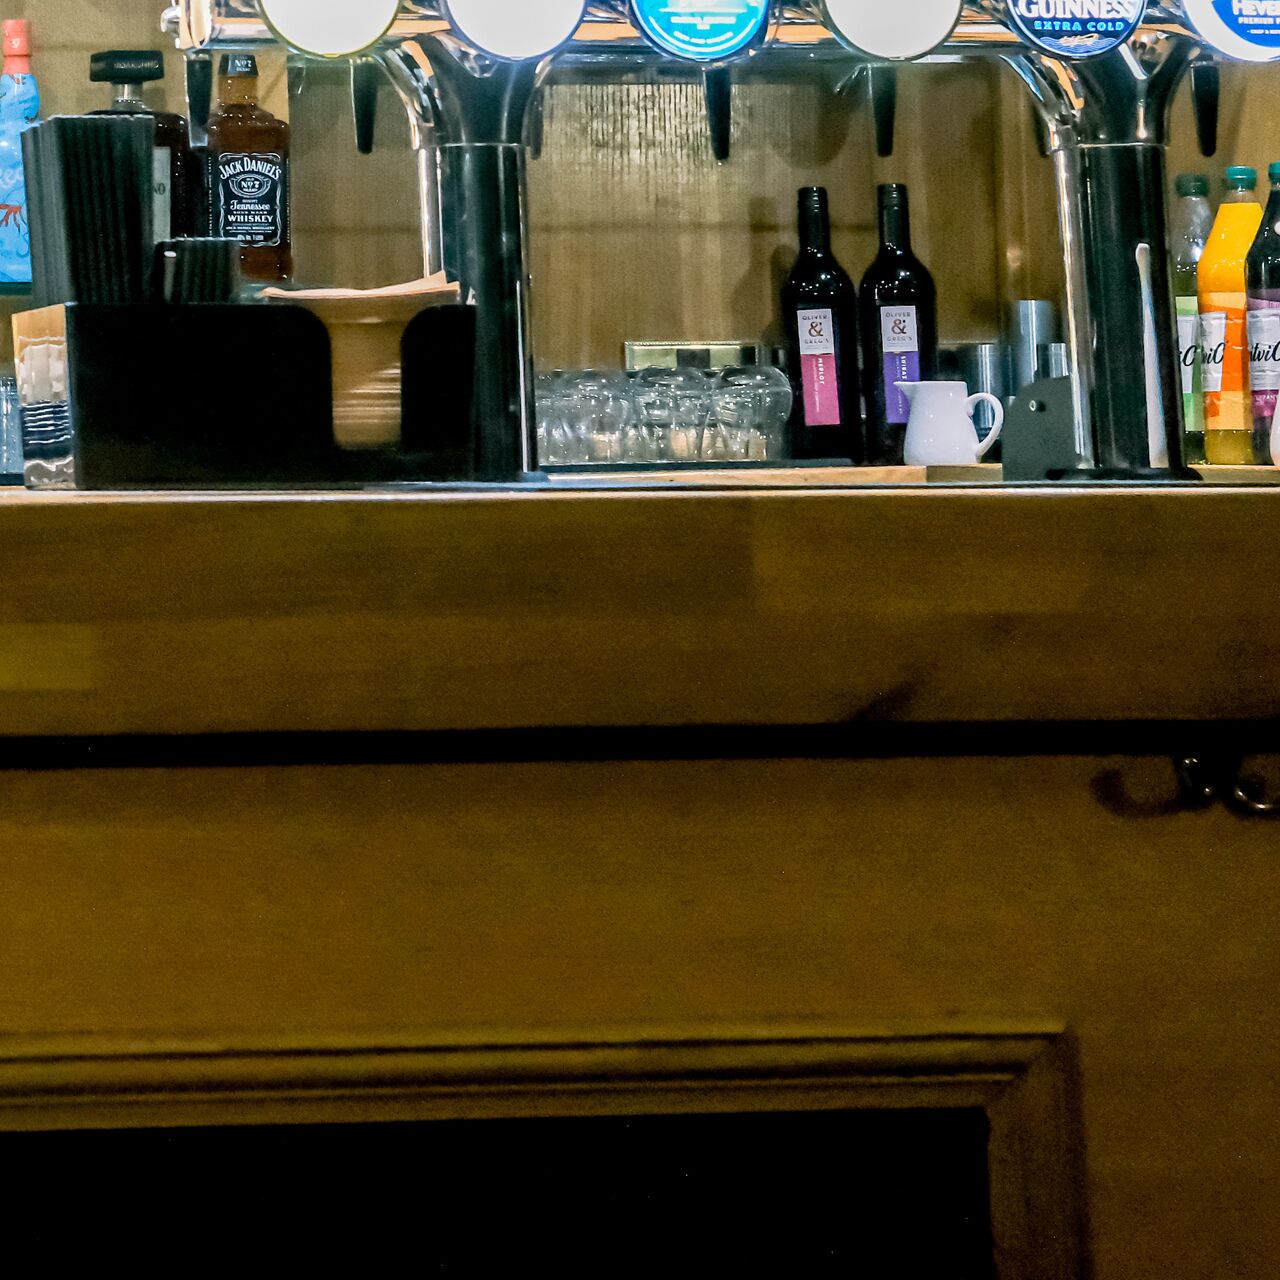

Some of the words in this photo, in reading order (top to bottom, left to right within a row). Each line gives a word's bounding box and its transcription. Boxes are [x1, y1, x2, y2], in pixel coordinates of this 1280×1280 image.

[1034, 21, 1081, 31] EXTRA
[1087, 21, 1125, 31] COLD
[219, 161, 243, 180] JACK
[244, 157, 281, 180] DANIEL'S
[230, 200, 270, 210] Tennessee
[228, 215, 273, 223] WHISKEY
[808, 322, 823, 337] &
[892, 319, 906, 334] &
